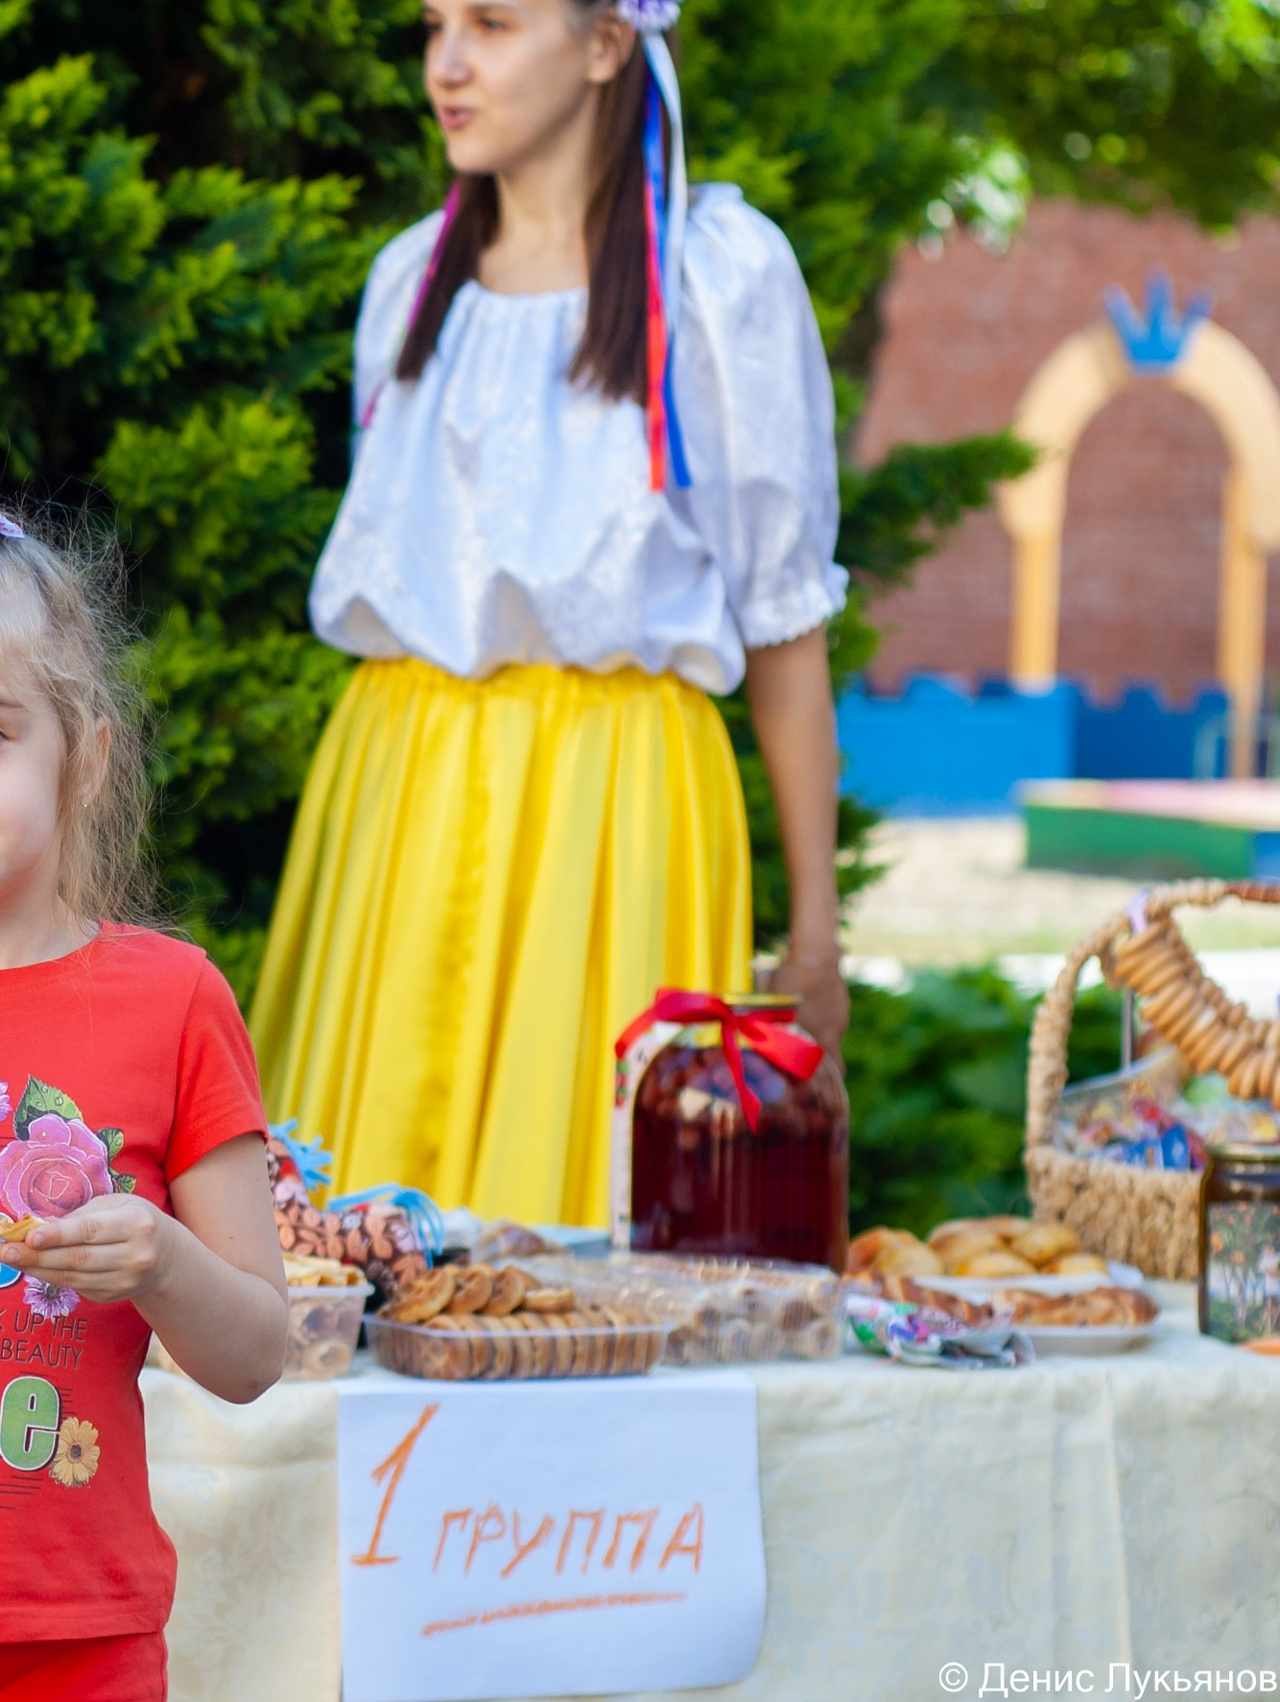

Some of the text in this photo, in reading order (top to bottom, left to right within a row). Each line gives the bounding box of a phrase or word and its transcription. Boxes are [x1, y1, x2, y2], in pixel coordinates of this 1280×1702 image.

[13, 1306, 46, 1335] UP
[54, 1314, 88, 1343] THE
[0, 1337, 84, 1371] BEAUTY
[350, 1403, 705, 1579] 1 ГРУППА
